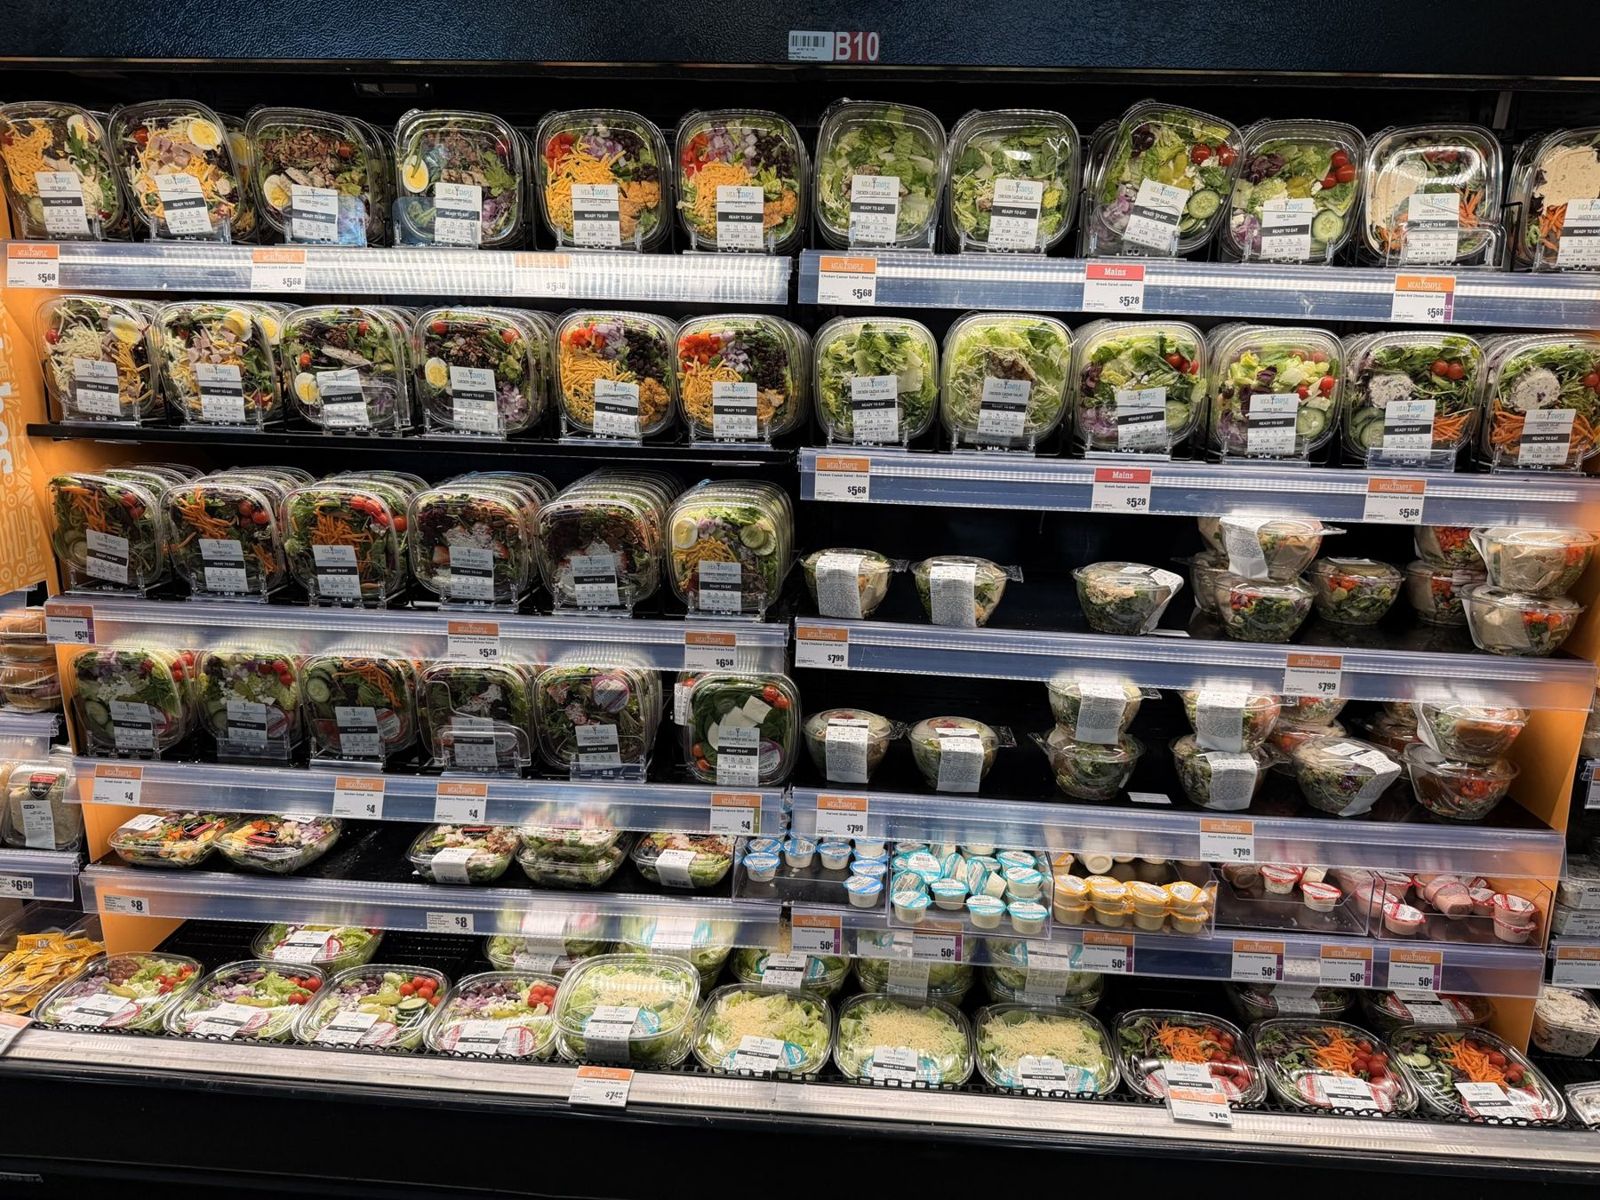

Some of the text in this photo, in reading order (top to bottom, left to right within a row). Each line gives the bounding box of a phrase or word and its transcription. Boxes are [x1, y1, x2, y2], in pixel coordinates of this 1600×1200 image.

[835, 31, 879, 61] B10
[1104, 268, 1126, 276] Mains
[37, 273, 56, 283] $568
[852, 289, 872, 299] $568
[1119, 296, 1140, 306] $528
[1112, 471, 1133, 479] Mains
[847, 486, 866, 496] $568
[1126, 498, 1146, 507] $528
[1399, 508, 1419, 518] $568
[479, 649, 497, 657] $528
[716, 659, 734, 667] $658
[827, 655, 844, 663] $799
[1318, 683, 1336, 692] $799
[125, 792, 134, 801] $4
[366, 804, 375, 813] $4
[469, 809, 478, 818] $4
[741, 821, 750, 830] $4
[847, 825, 863, 834] $799
[1233, 848, 1250, 857] $799
[11, 880, 32, 891] $699
[131, 900, 143, 911] $8
[455, 917, 467, 927] $8
[820, 941, 833, 950] 50¢
[941, 948, 954, 957] 50¢
[1112, 959, 1125, 968] 50¢
[1262, 967, 1275, 976] 50¢
[1350, 973, 1364, 982] 50¢
[1418, 977, 1432, 986] 50¢
